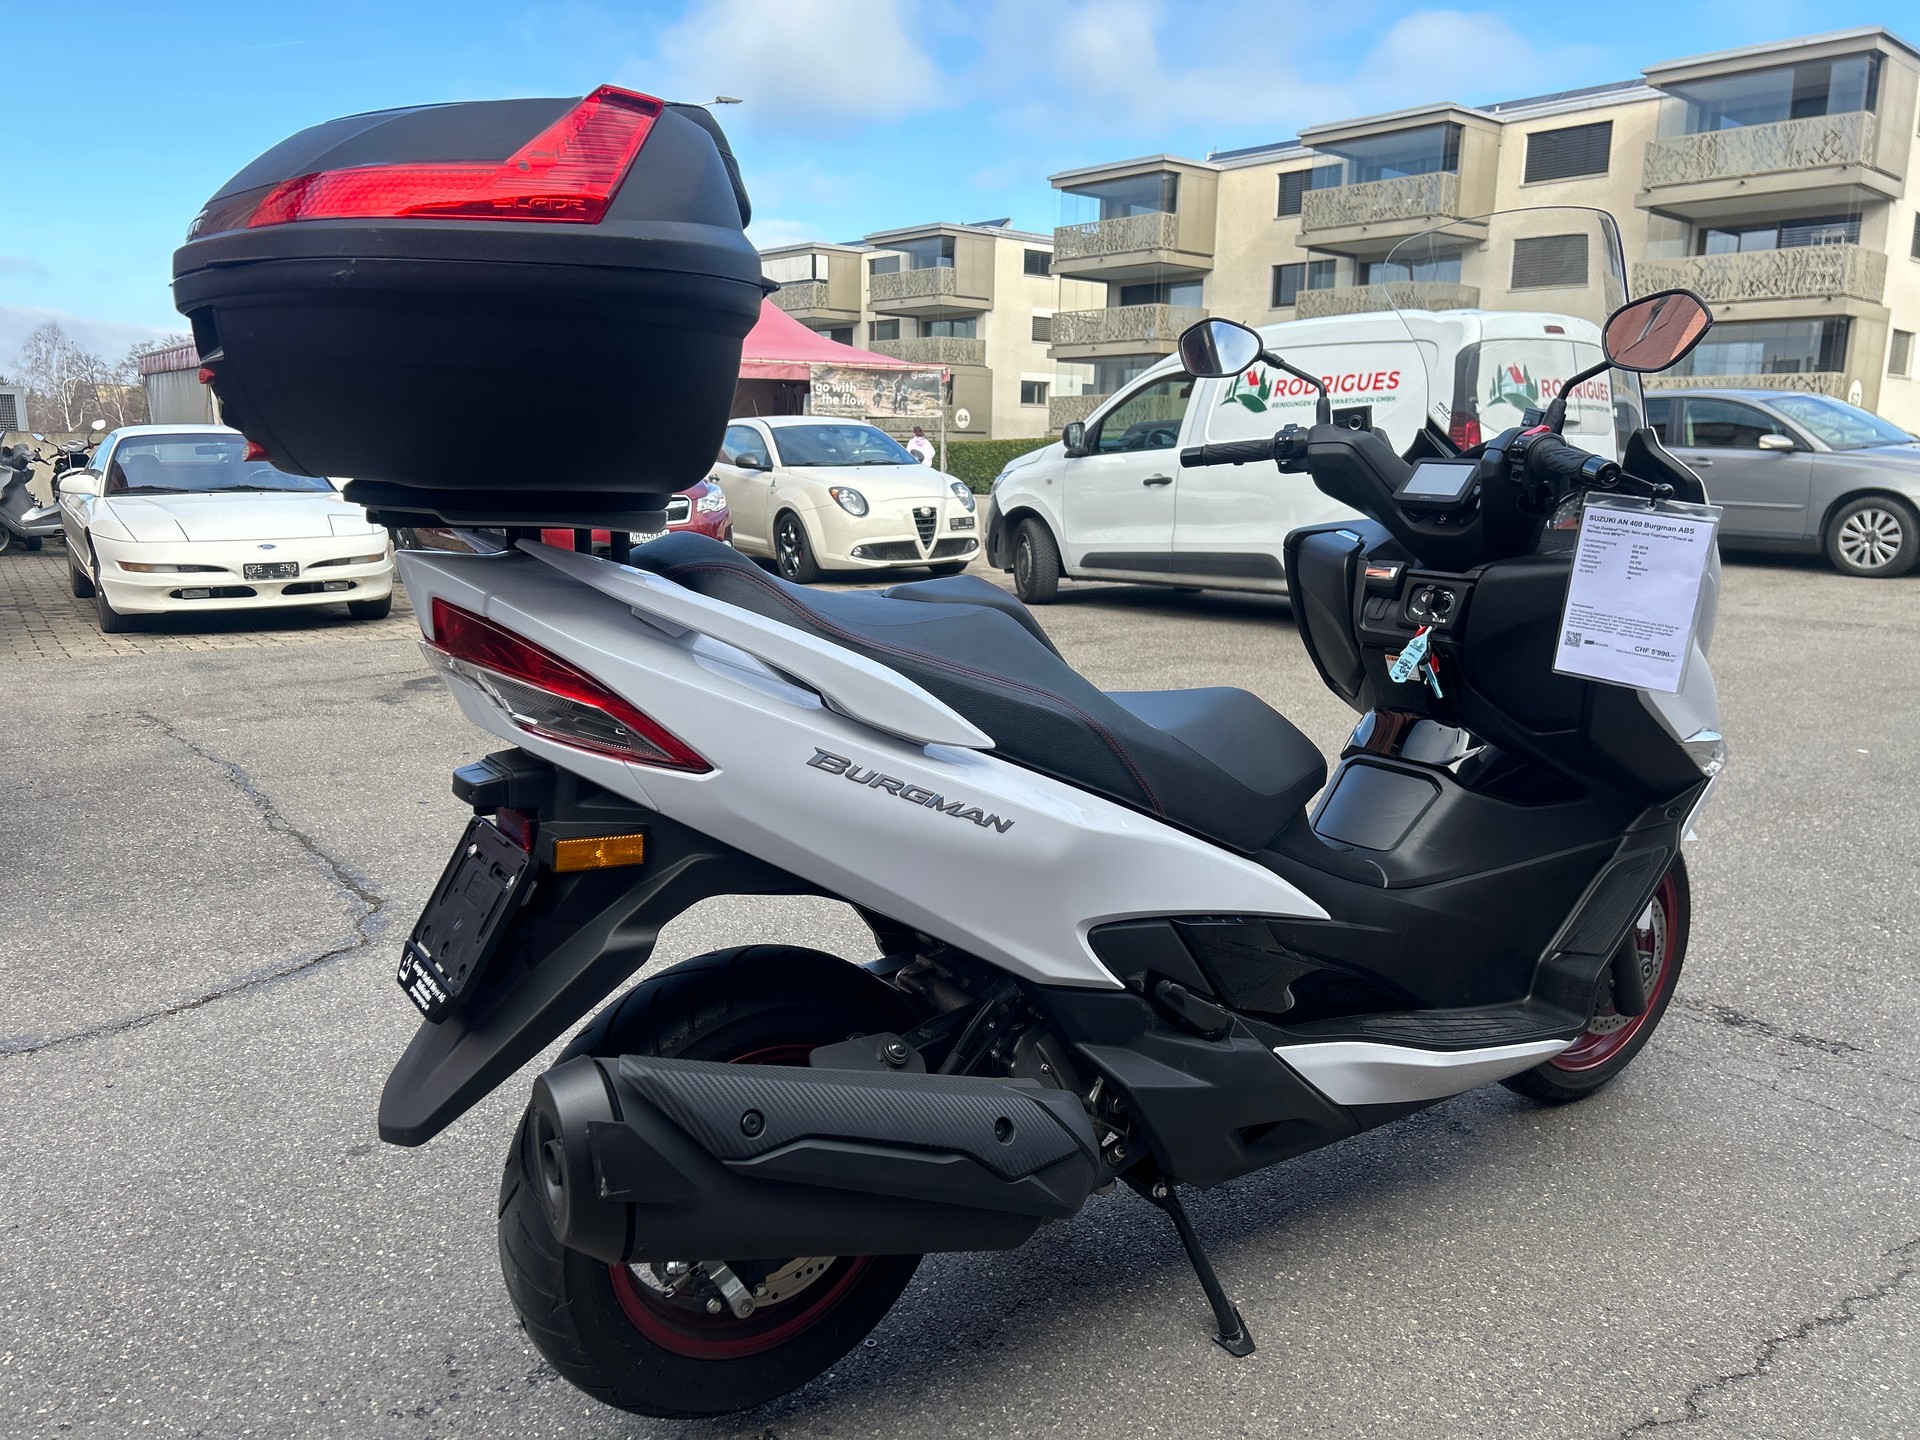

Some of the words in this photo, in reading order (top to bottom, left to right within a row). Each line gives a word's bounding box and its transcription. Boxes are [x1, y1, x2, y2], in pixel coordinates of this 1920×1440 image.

[815, 383, 830, 395] go
[832, 381, 857, 393] with
[1274, 371, 1400, 397] RODRIGUES
[821, 393, 840, 405] the
[841, 394, 865, 406] flow
[1589, 515, 1616, 525] SUZUKI
[1617, 518, 1629, 526] AN
[1630, 520, 1643, 528] 400
[1644, 522, 1677, 532] Burgman
[1678, 526, 1695, 535] ABS
[1634, 645, 1650, 654] CHF
[806, 746, 1015, 833] BURGMAN
